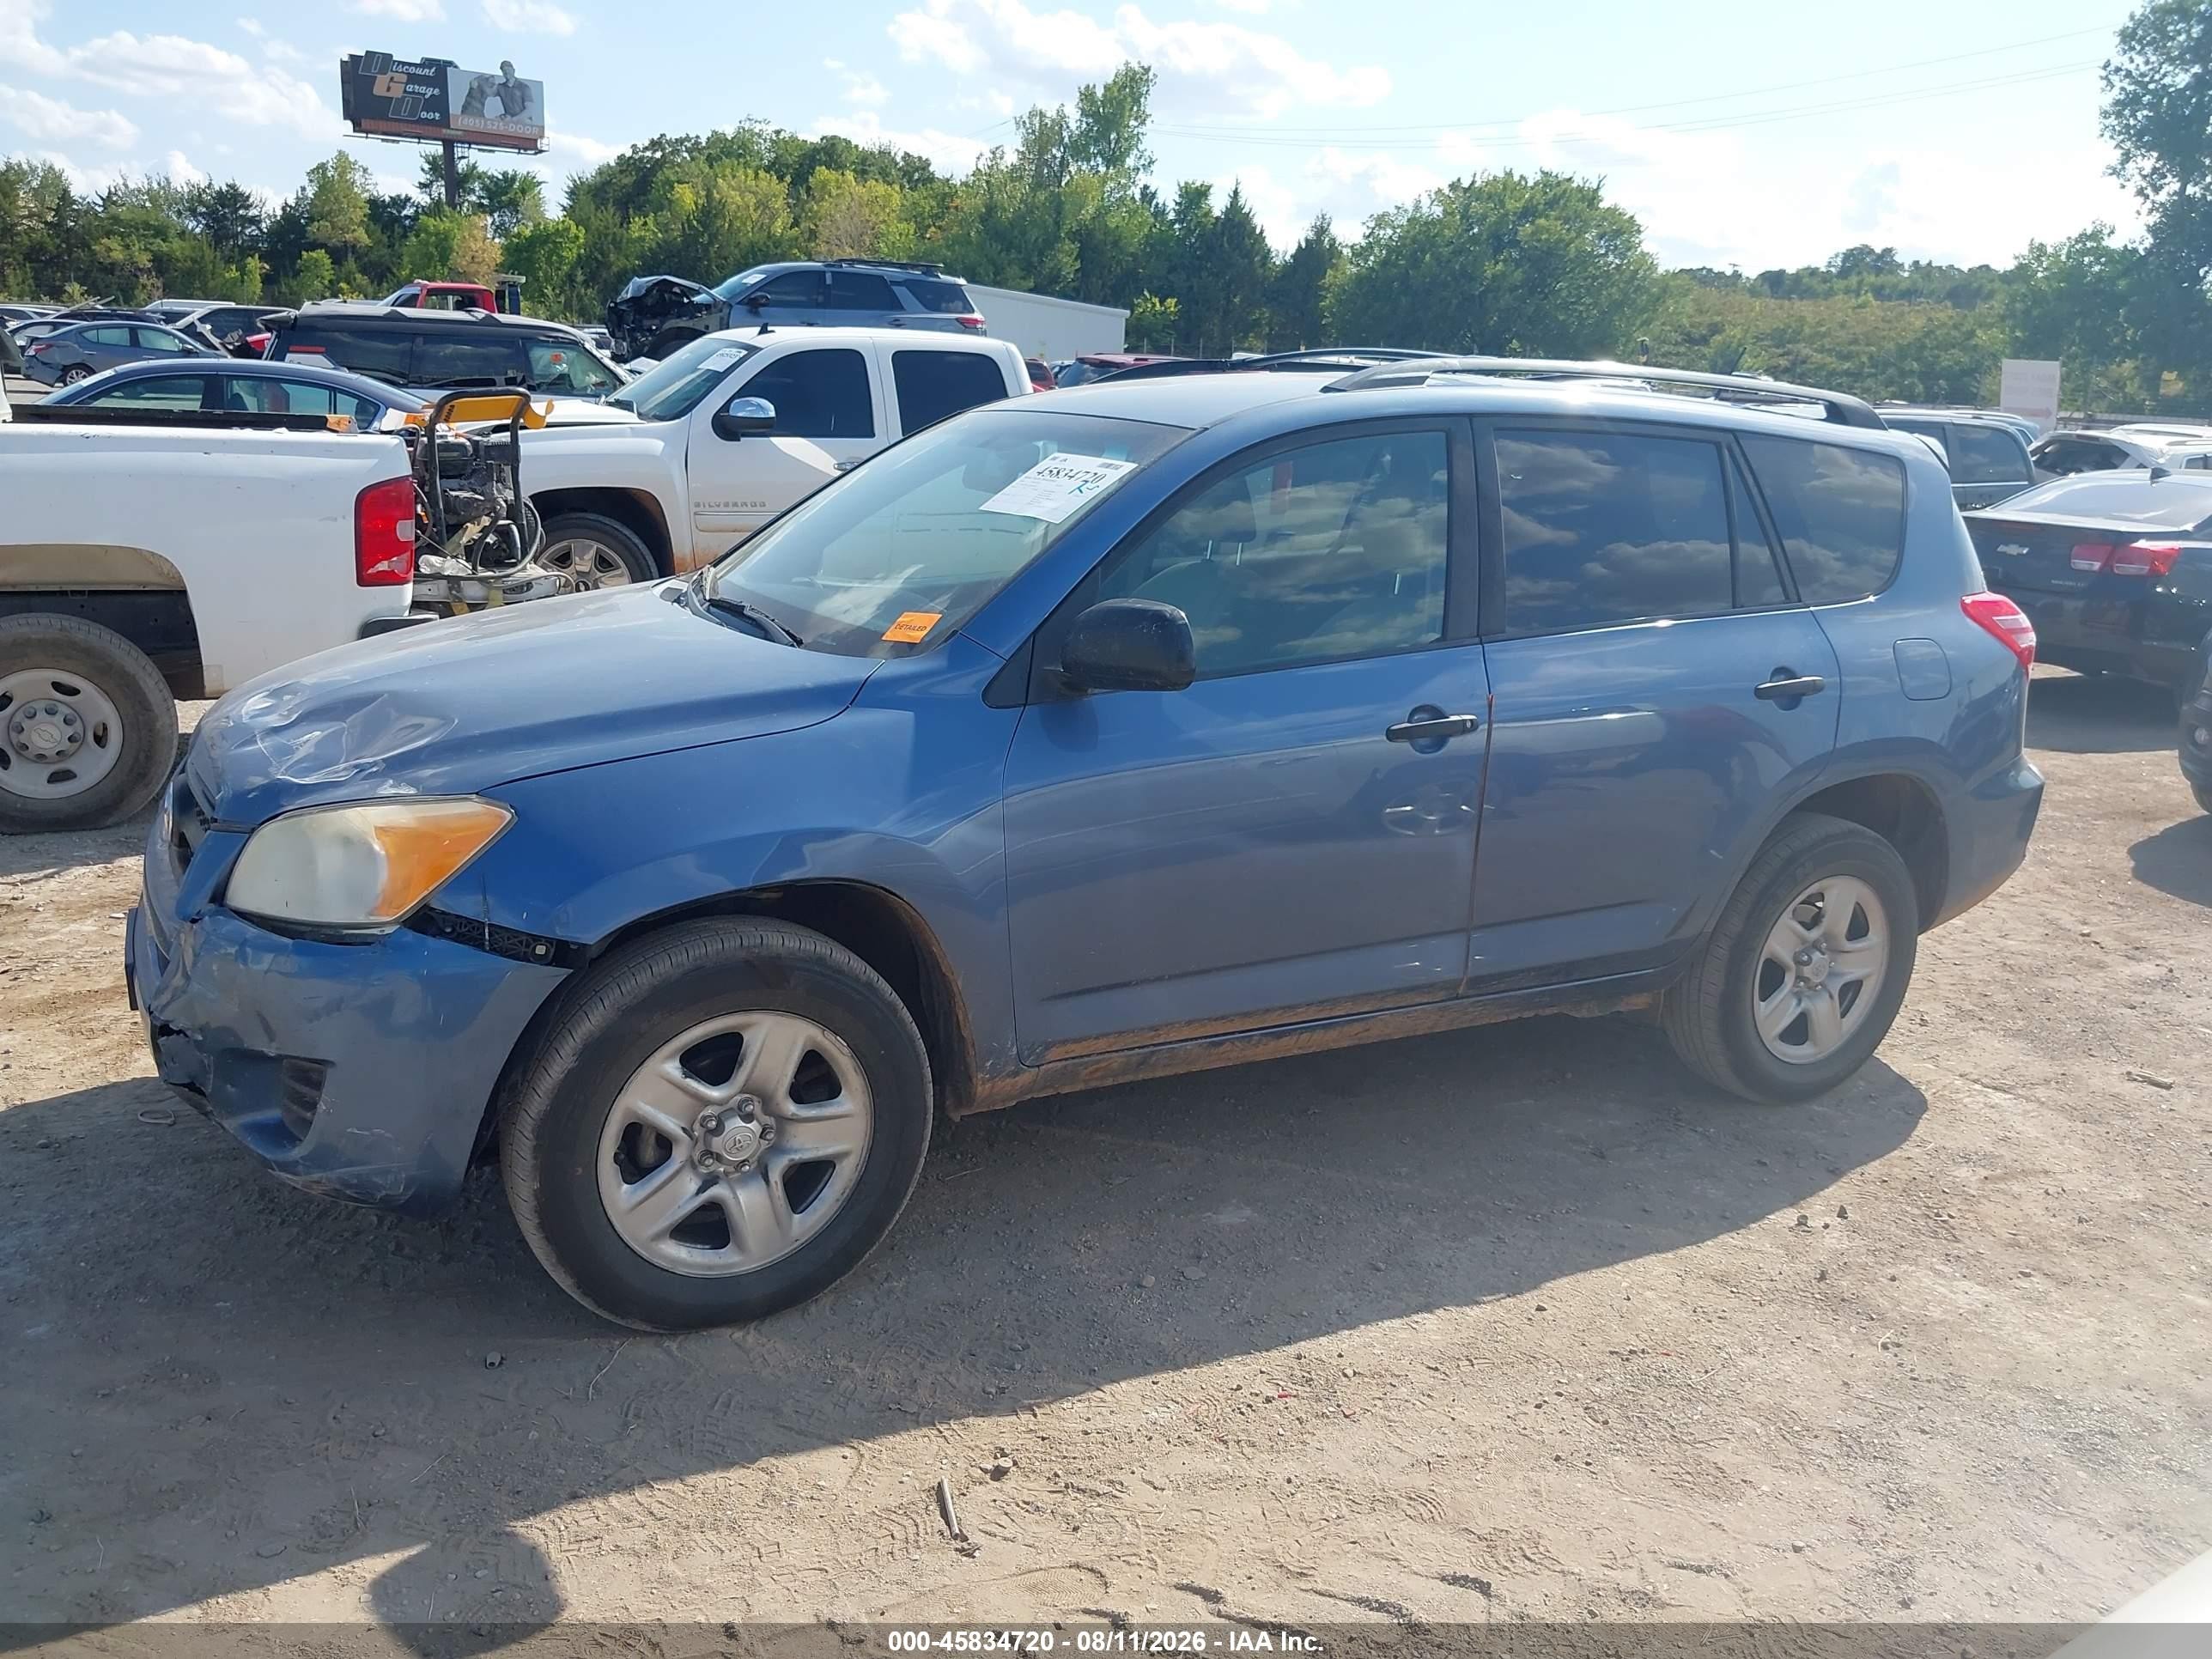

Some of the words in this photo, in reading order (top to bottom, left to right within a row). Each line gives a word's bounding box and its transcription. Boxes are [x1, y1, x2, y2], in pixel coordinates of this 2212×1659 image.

[358, 50, 436, 76] Discount
[373, 73, 441, 99] Garage
[389, 94, 441, 120] Door
[1036, 466, 1107, 483] 45834720
[895, 623, 927, 632] DETAILED
